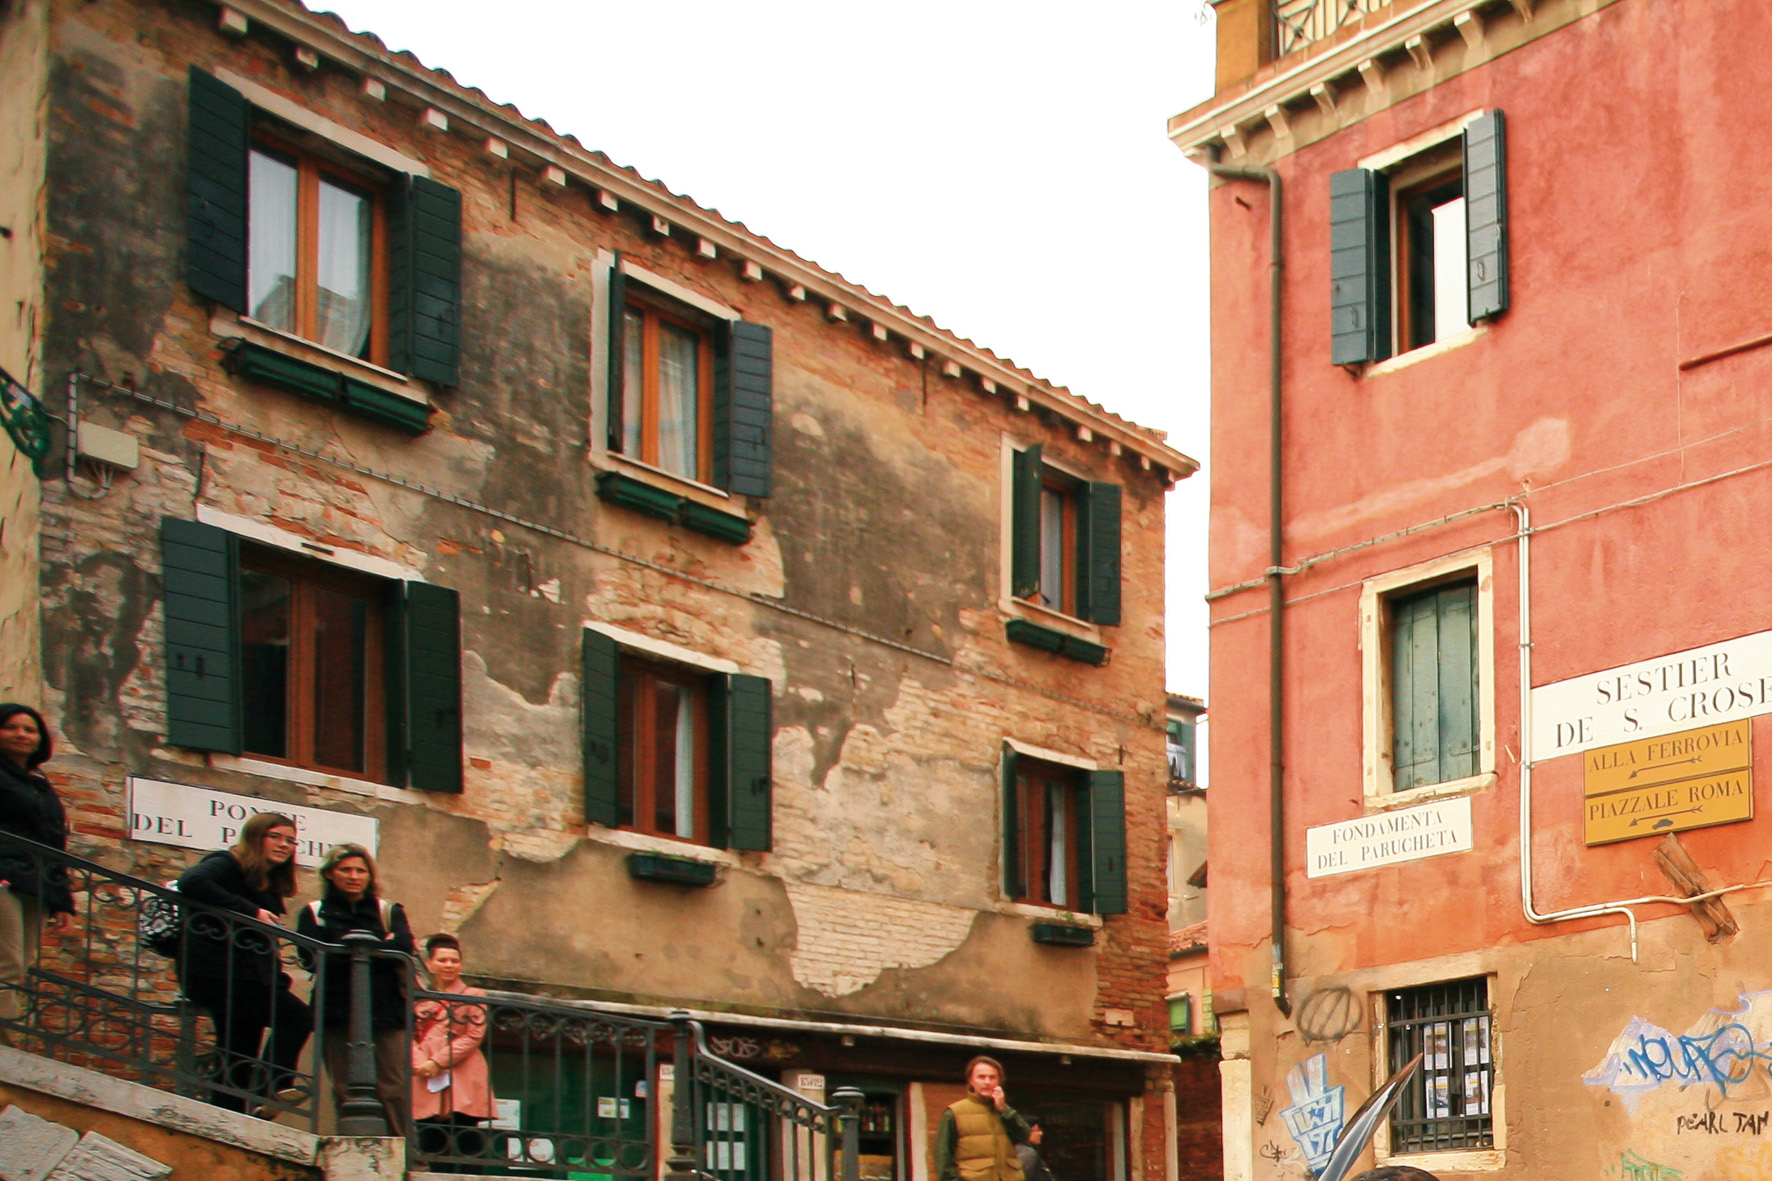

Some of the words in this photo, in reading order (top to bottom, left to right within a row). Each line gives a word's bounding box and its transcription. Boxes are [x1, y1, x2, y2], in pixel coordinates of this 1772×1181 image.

[1596, 652, 1732, 706] SESTIER
[1556, 716, 1594, 748] DE
[1624, 707, 1643, 733] S.
[1589, 749, 1636, 772] ALLA
[1647, 729, 1743, 761] FERROVIA
[210, 800, 306, 831] POE
[1589, 789, 1678, 821] PIAZZALE
[1688, 779, 1743, 803] ROMA
[134, 813, 192, 838] DEL
[1333, 810, 1443, 844] FONDAMENTA
[1318, 851, 1348, 870] DEL
[1361, 829, 1457, 861] PARUCHETA
